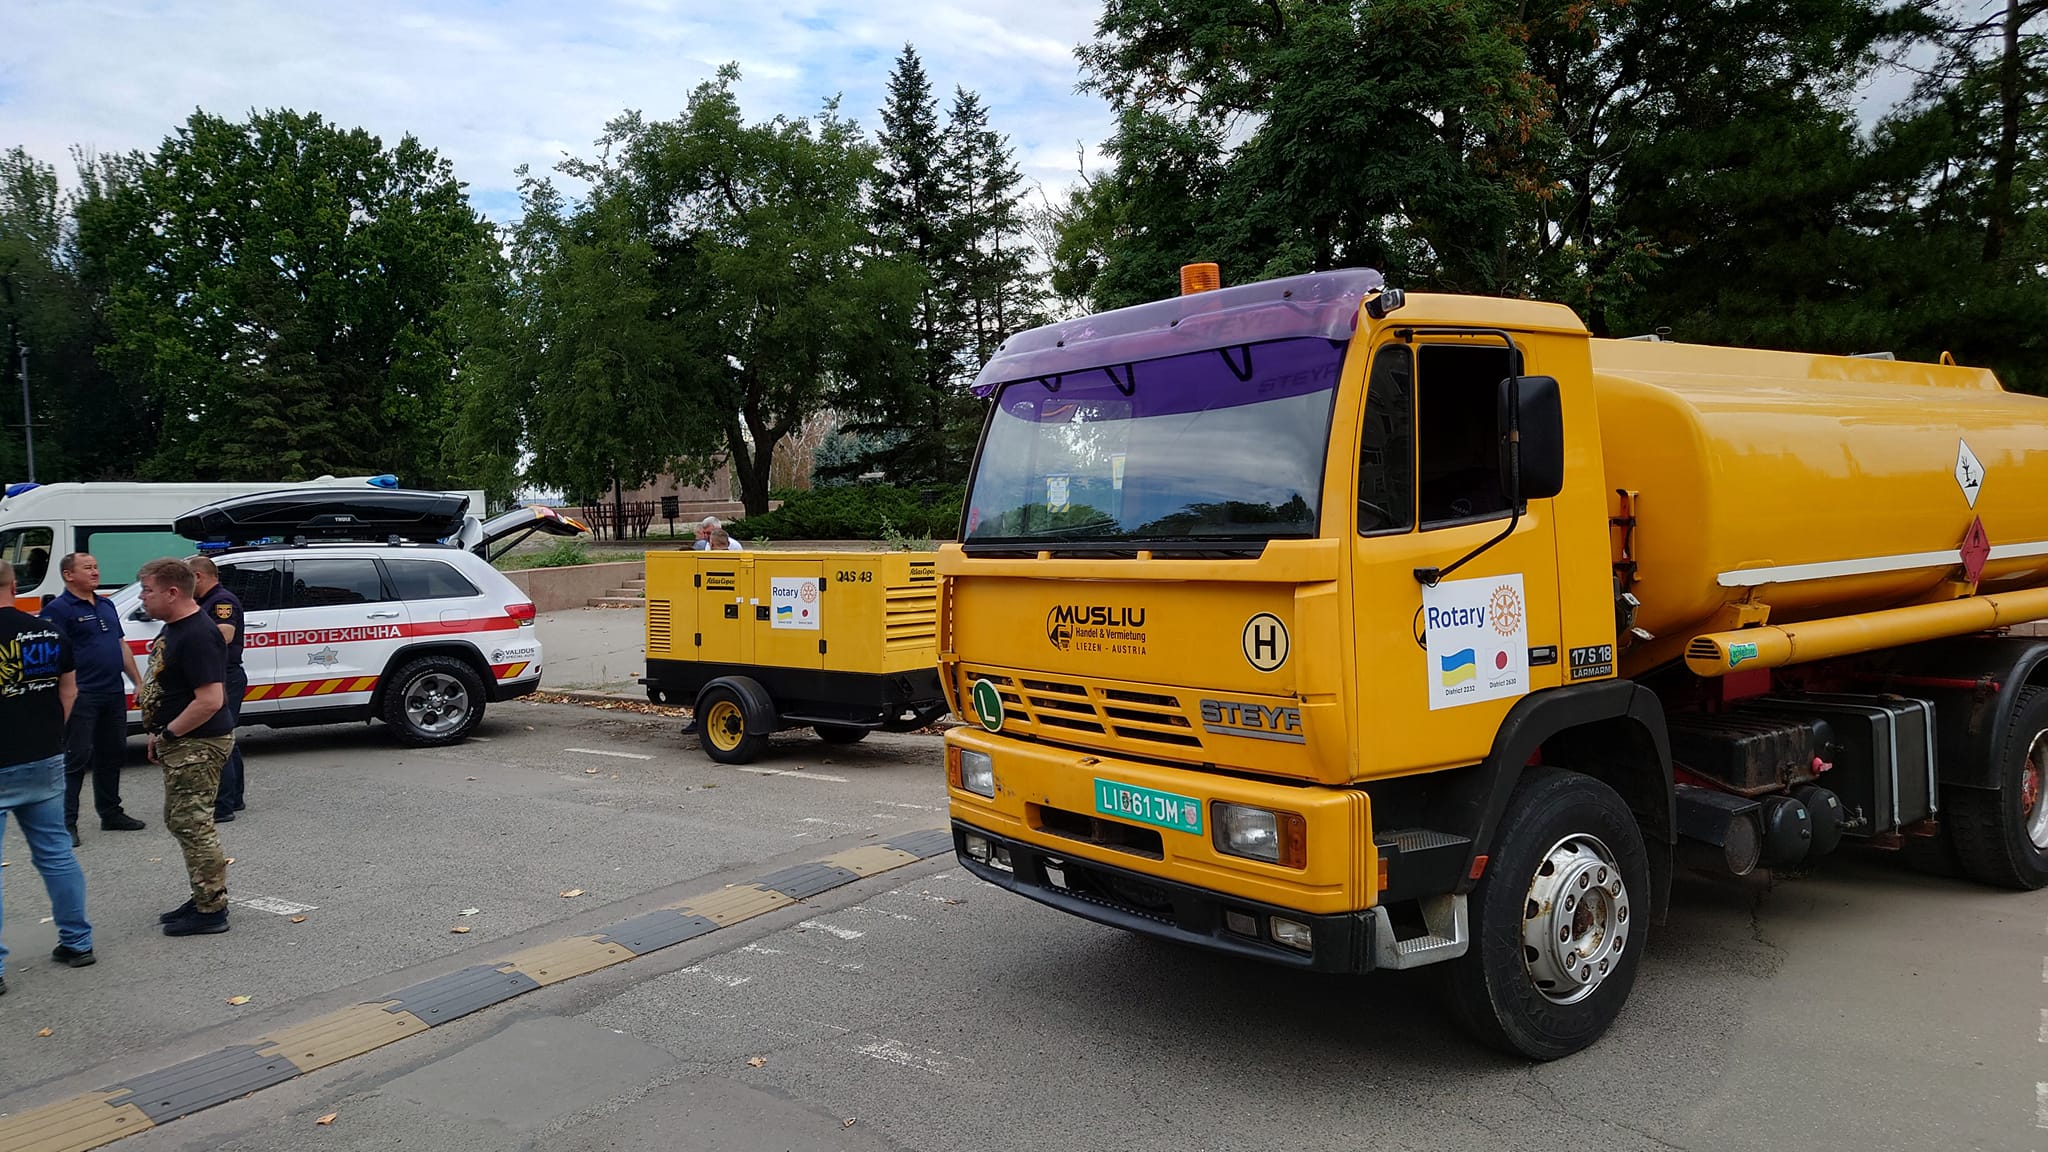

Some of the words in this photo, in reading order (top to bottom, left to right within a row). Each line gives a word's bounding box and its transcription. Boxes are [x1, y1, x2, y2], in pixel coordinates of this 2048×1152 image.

[836, 571, 856, 583] QAS
[772, 587, 799, 598] Rotary
[1055, 605, 1146, 628] MUSLIU
[1428, 606, 1485, 630] Rotary
[1076, 627, 1098, 639] Handel
[1100, 628, 1105, 639] &
[1106, 629, 1146, 643] Vermietung
[1255, 625, 1276, 660] H
[1076, 642, 1102, 652] LIEZEN
[1112, 645, 1146, 655] AUSTRIA
[1572, 649, 1586, 665] 17
[1588, 648, 1597, 663] S
[1599, 646, 1612, 662] 18
[1445, 687, 1463, 696] District
[1490, 680, 1506, 688] District
[979, 690, 996, 722] L
